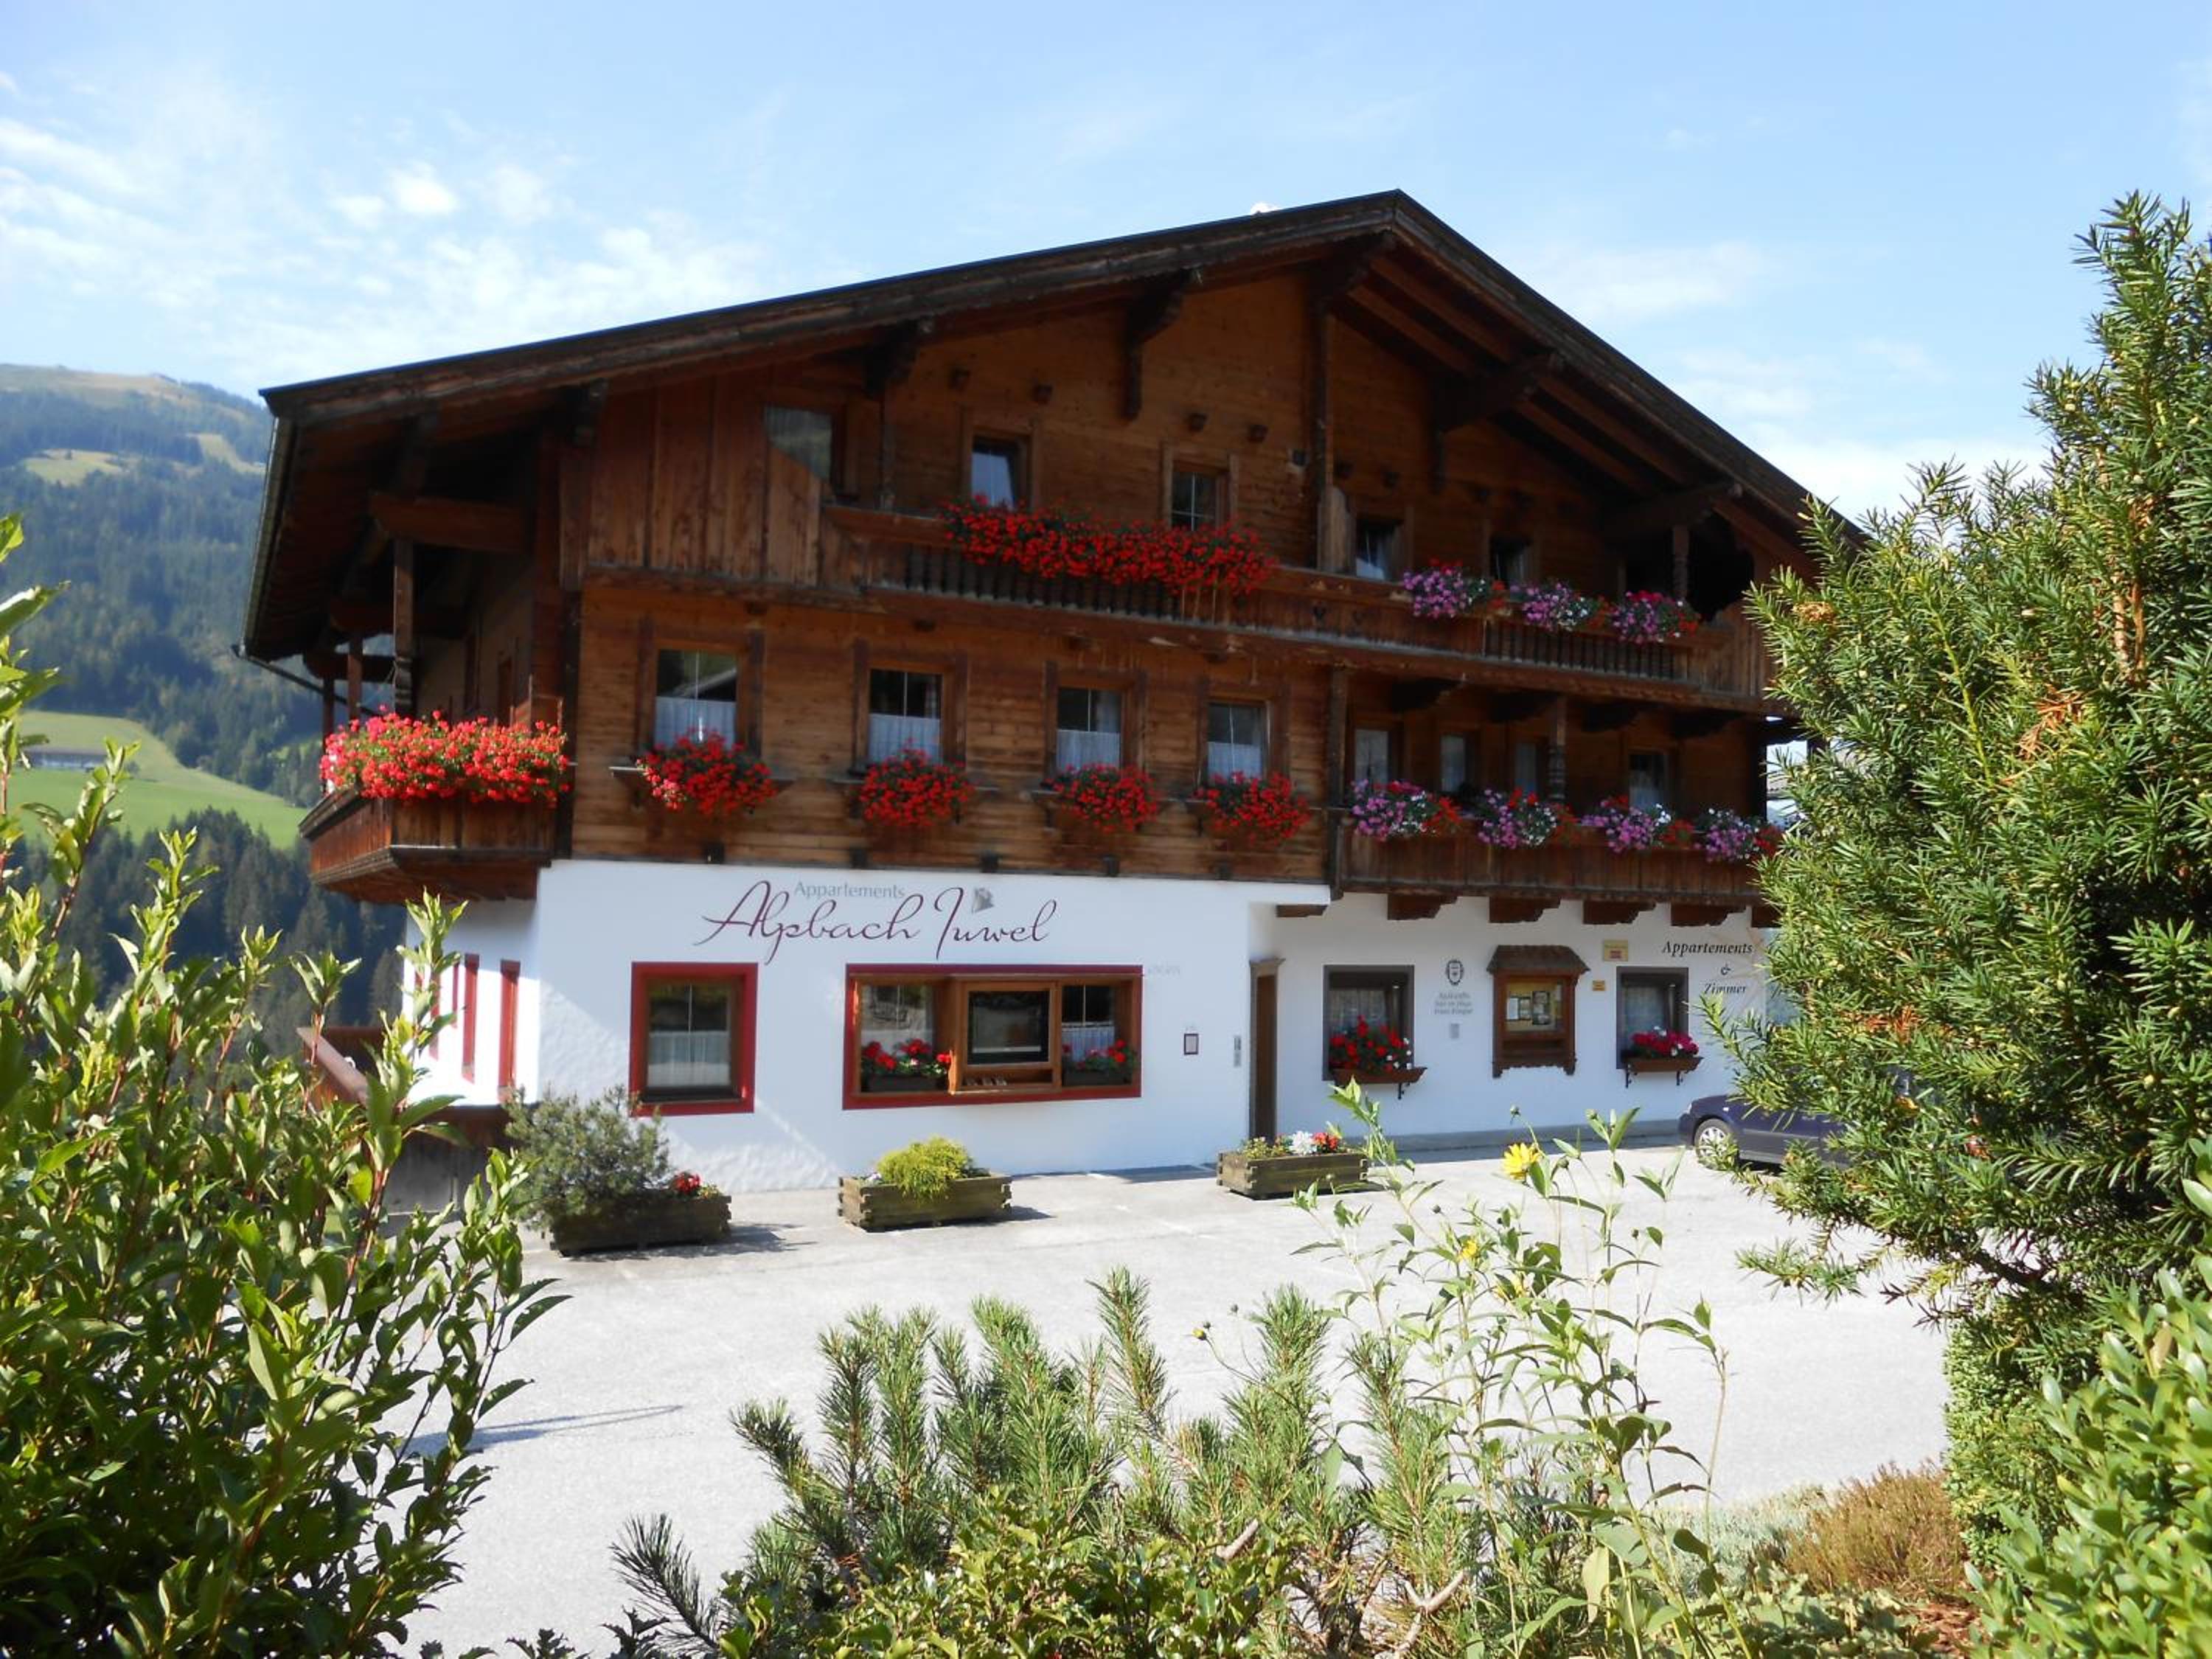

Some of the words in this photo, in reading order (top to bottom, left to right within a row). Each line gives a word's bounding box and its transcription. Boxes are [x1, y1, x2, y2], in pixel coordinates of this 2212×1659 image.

[793, 880, 906, 900] Appartements
[692, 880, 924, 965] Alpbach
[934, 887, 1057, 960] Juwel
[1663, 941, 1753, 957] Appartements
[1704, 982, 1747, 994] Zimmer
